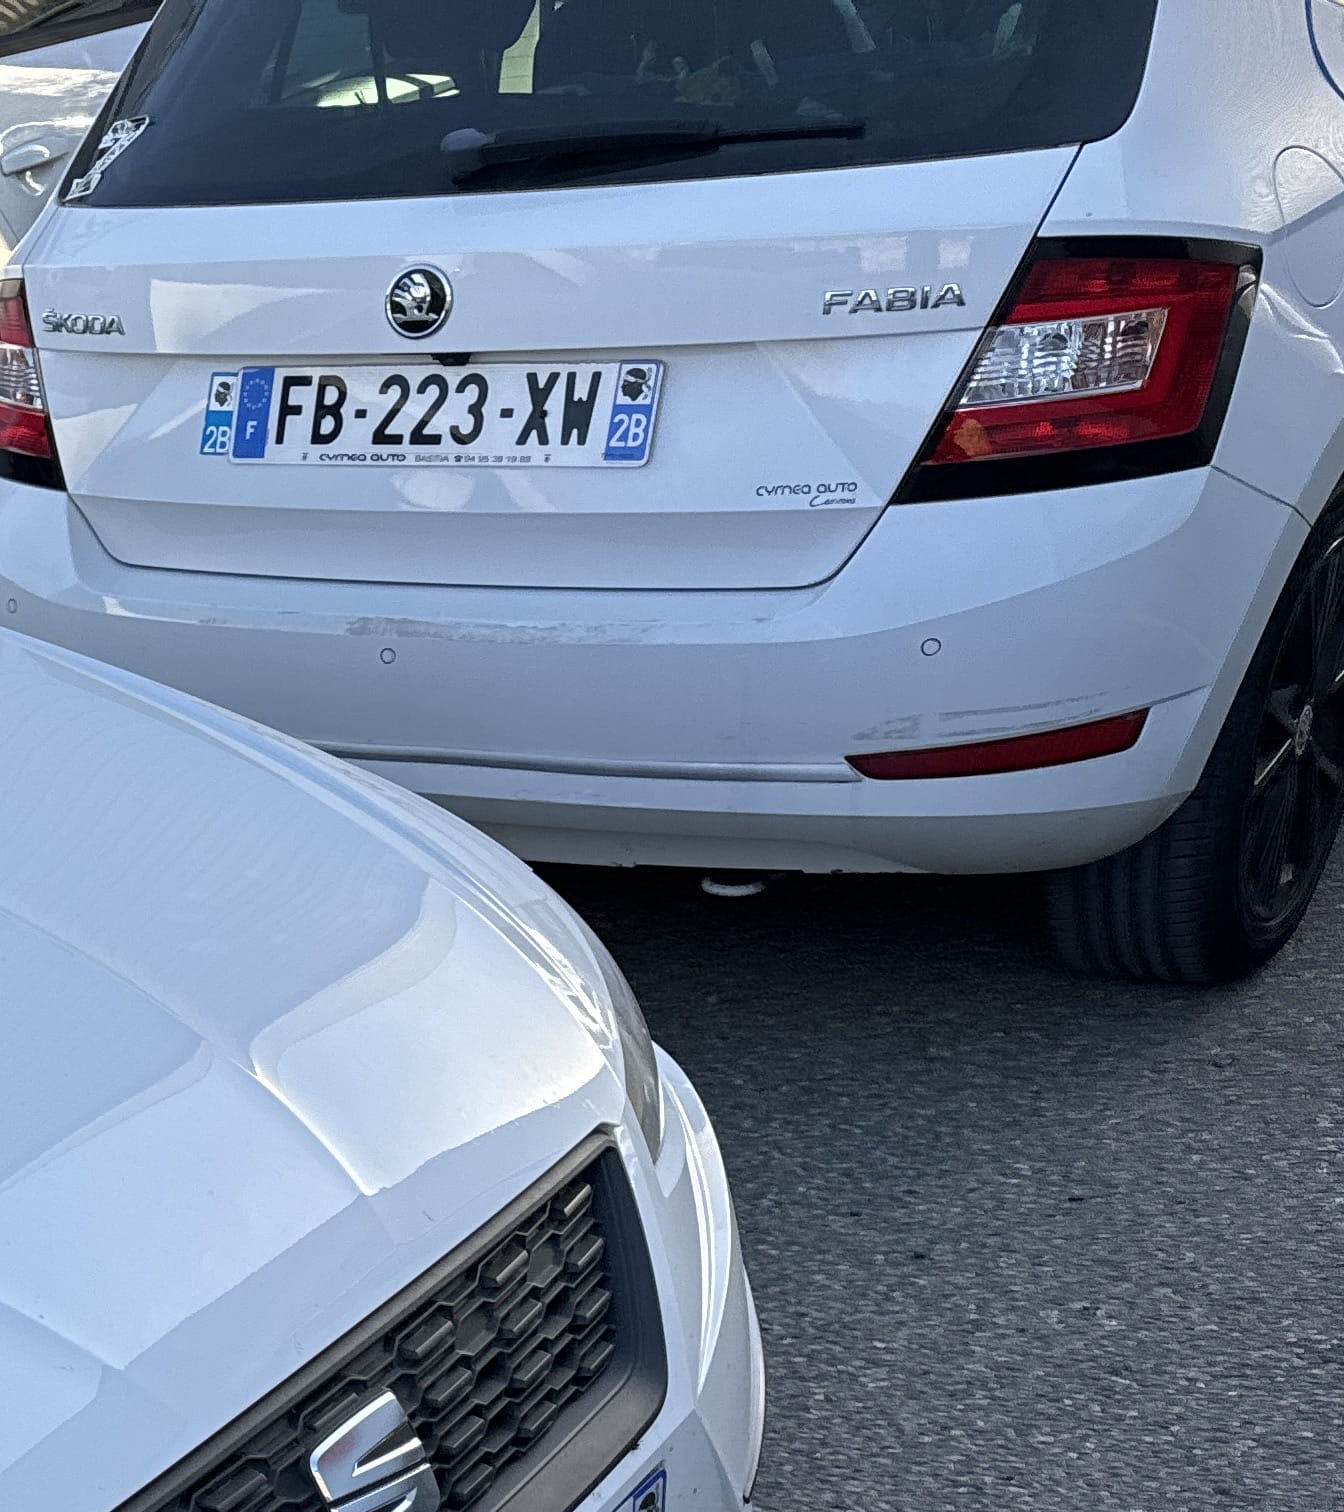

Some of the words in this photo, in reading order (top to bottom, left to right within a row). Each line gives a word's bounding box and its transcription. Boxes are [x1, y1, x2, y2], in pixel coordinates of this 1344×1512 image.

[822, 282, 966, 315] FABIA
[275, 371, 601, 446] FB-223-XW
[203, 426, 230, 453] 2B
[245, 420, 258, 440] F
[609, 413, 647, 447] 2B
